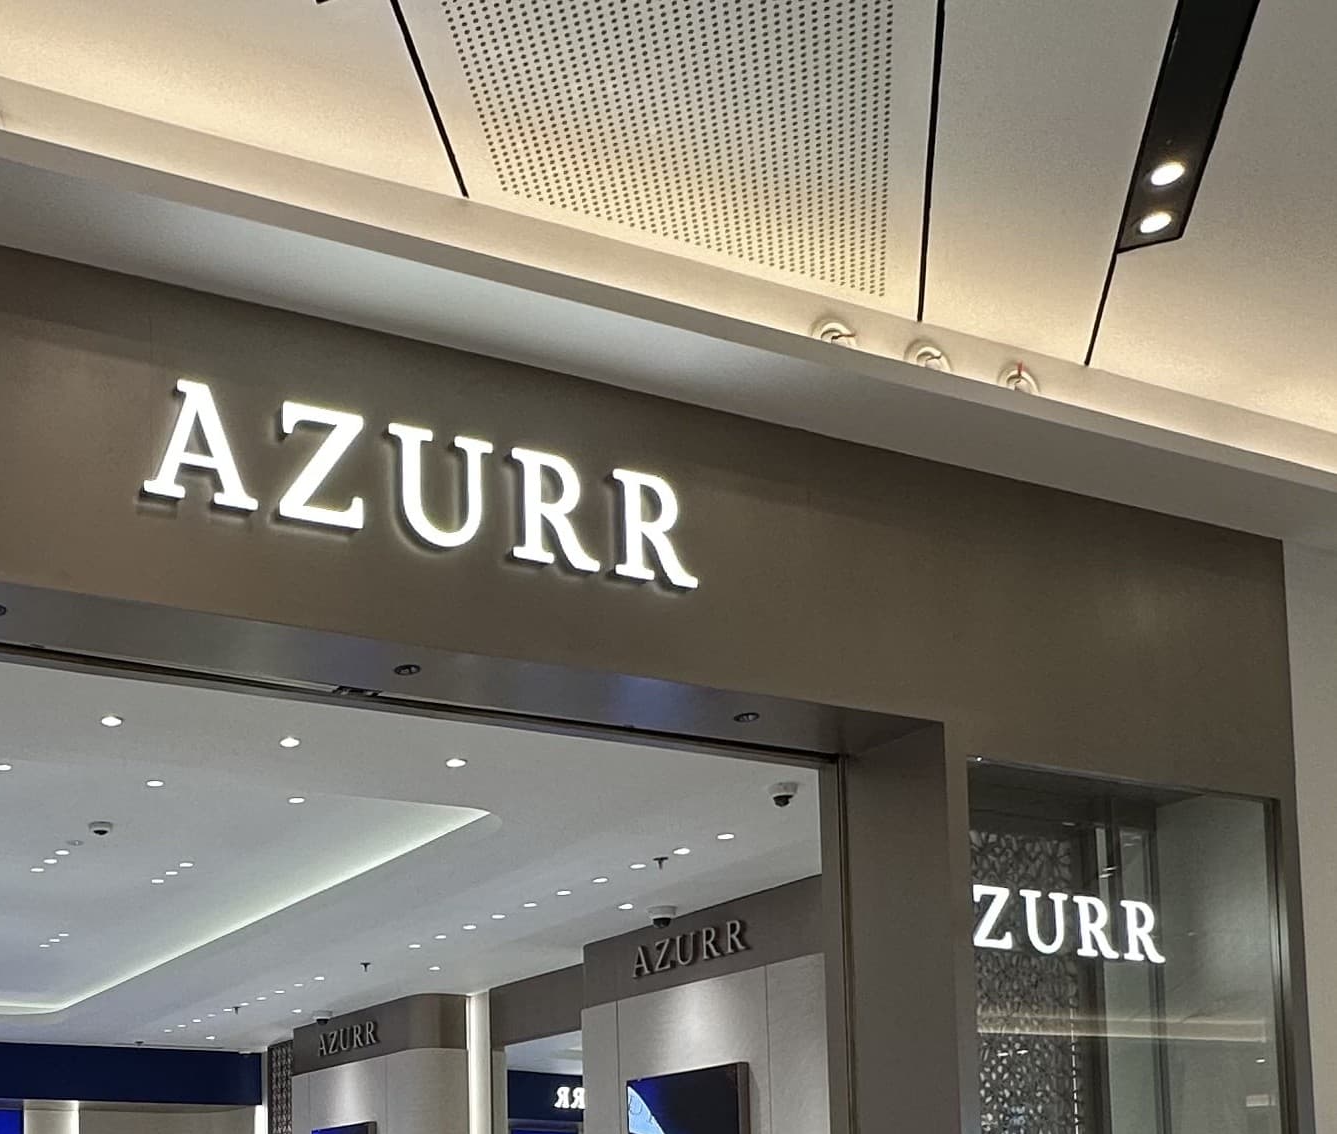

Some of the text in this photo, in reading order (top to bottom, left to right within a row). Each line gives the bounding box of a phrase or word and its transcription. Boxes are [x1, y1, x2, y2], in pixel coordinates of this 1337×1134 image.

[143, 378, 699, 589] AZURR
[632, 920, 747, 978] AZURR
[973, 884, 1166, 963] ZURR
[318, 1021, 377, 1057] AZURR
